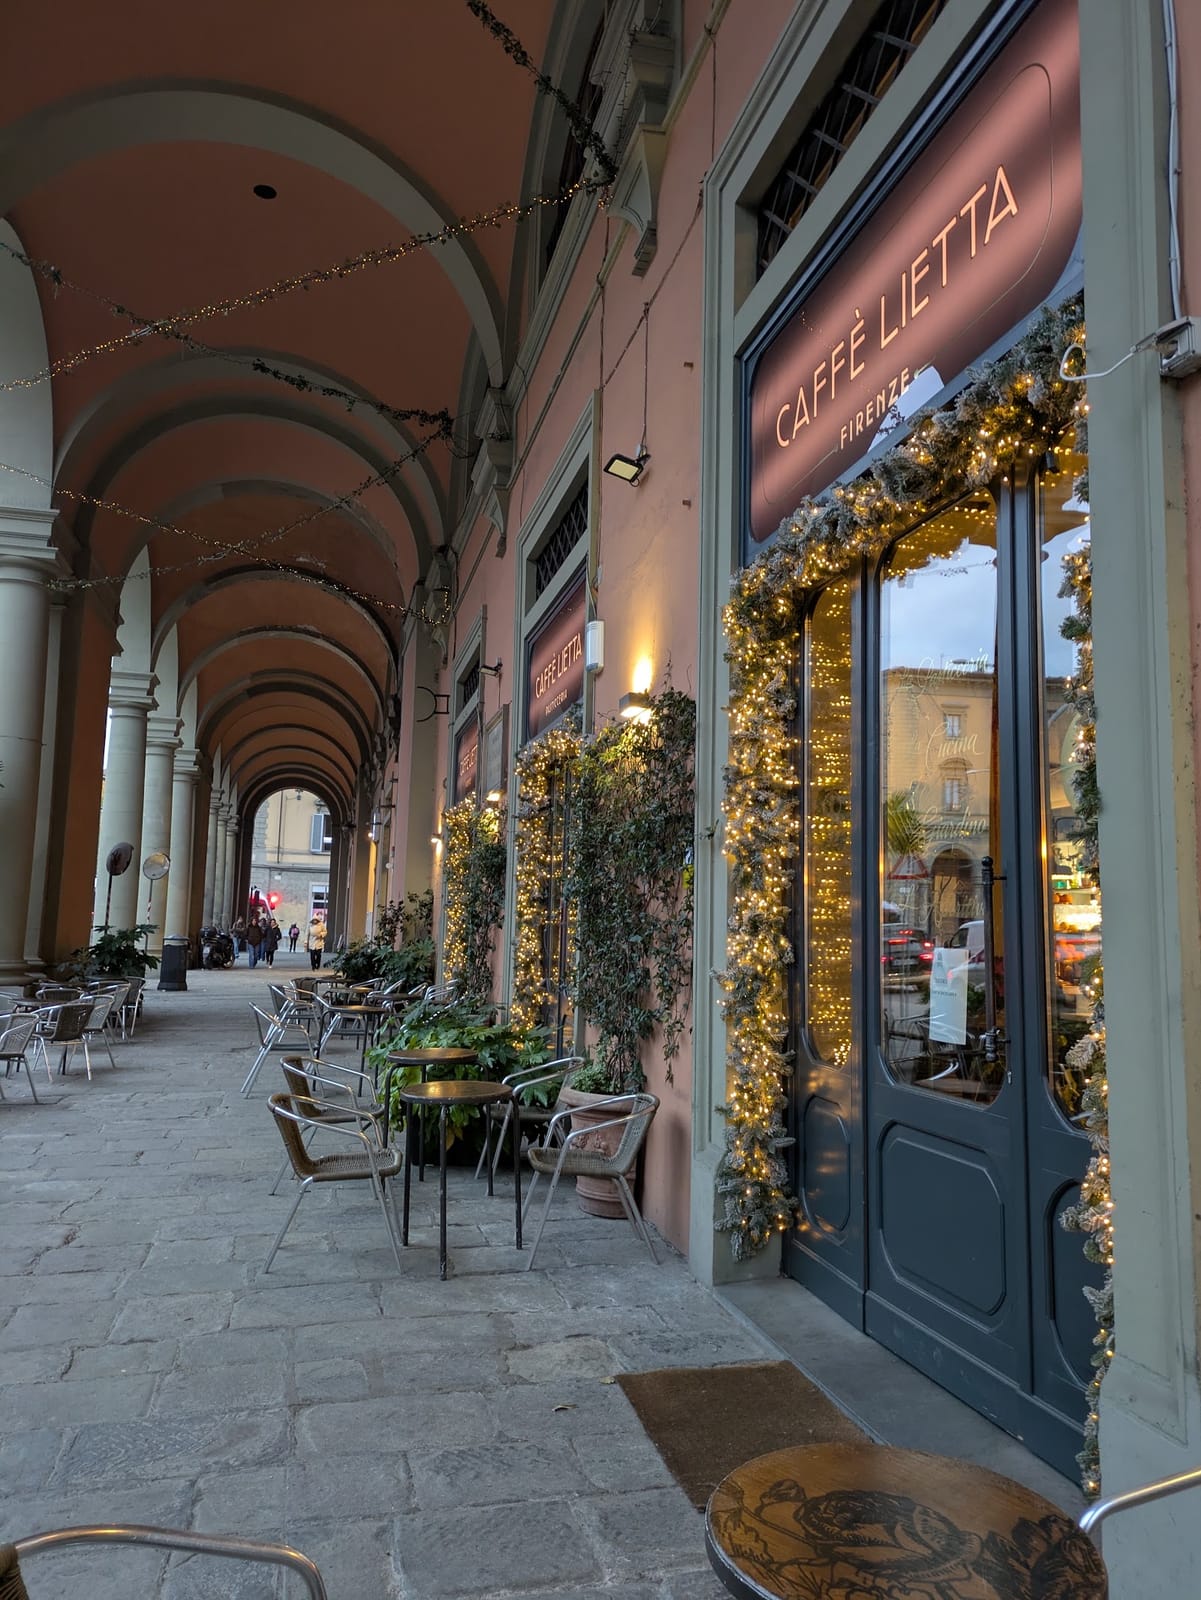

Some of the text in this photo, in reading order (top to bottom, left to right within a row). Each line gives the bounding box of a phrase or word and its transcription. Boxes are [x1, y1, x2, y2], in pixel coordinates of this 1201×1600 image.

[776, 164, 1019, 448] CAFFÈ LIETTA
[840, 367, 910, 450] FIRENZE
[535, 632, 582, 698] CAFFÈ LIETTA
